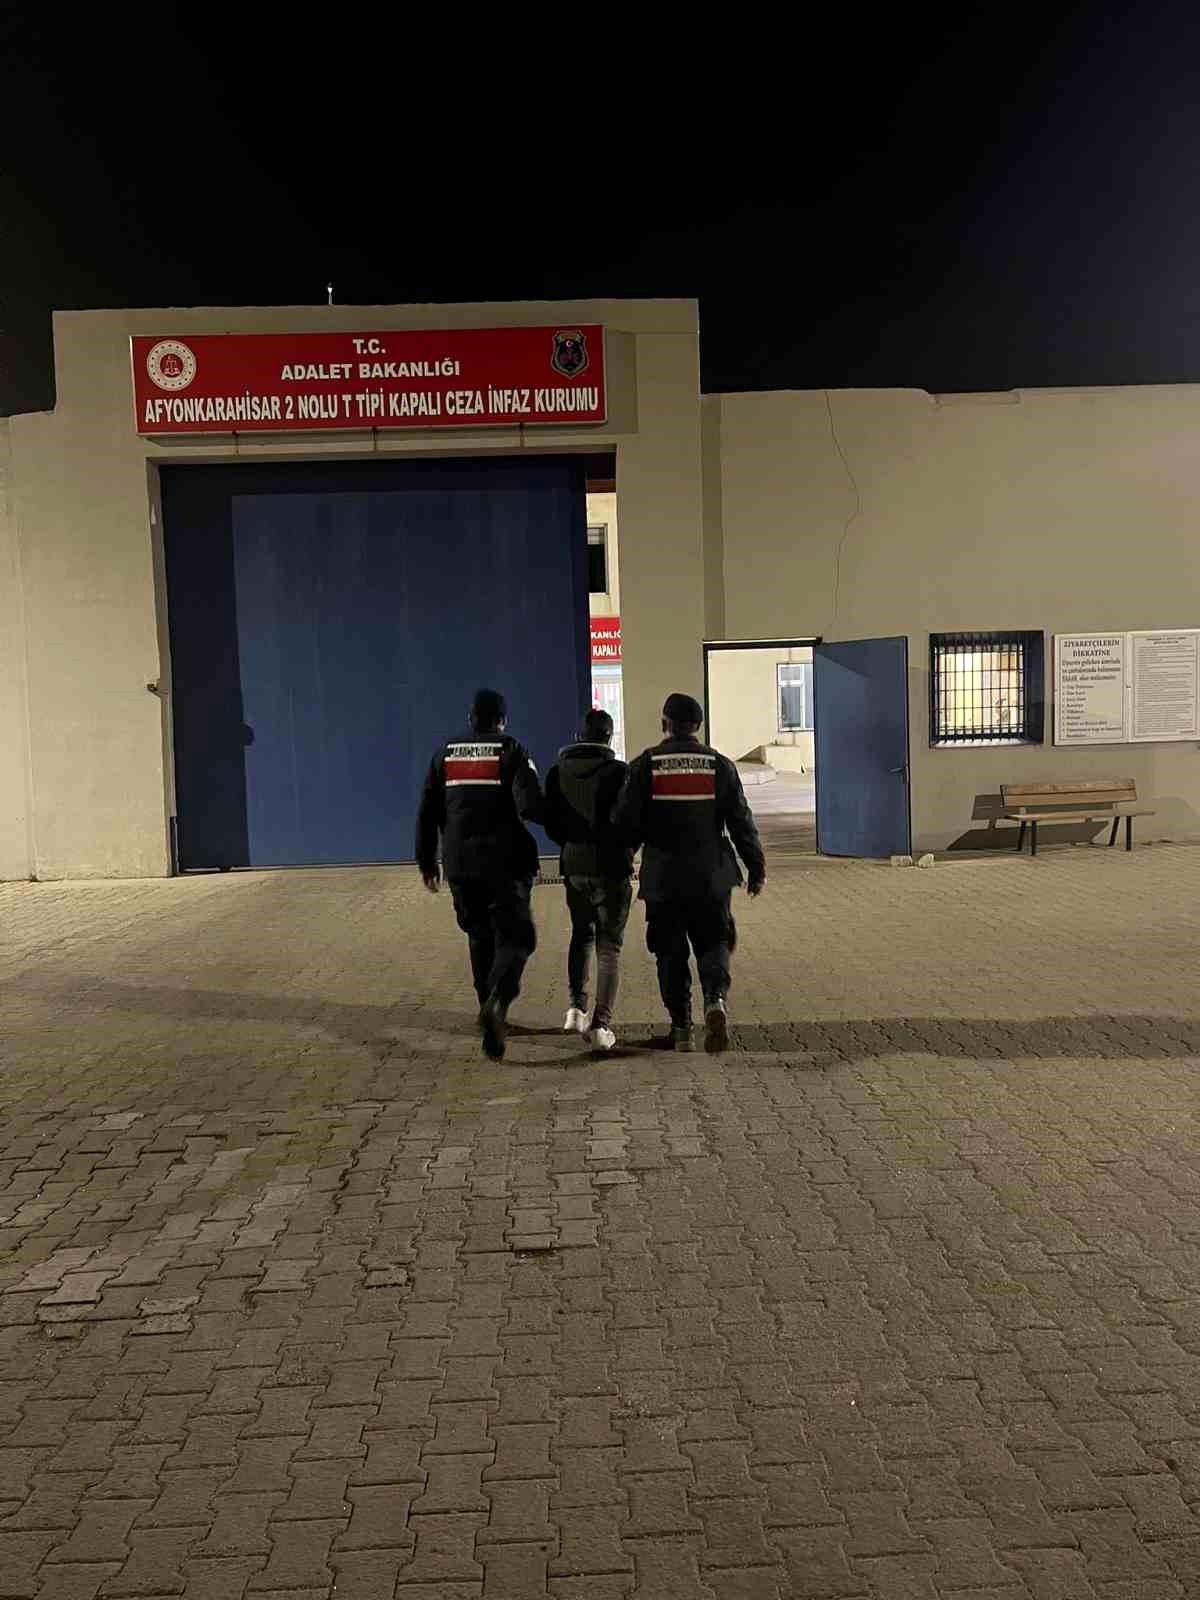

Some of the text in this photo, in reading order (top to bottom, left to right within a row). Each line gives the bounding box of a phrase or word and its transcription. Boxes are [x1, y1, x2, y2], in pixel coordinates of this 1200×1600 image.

[353, 338, 387, 355] T.C.
[281, 358, 460, 380] ADALET BAKANLIĞI
[145, 384, 599, 423] AFYONKARAHİSAR 2 NOLU T TİPİ KAPALI CEZA İNFAZ KURUMU
[592, 644, 618, 656] KAPALI
[657, 758, 711, 770] JANDARMA
